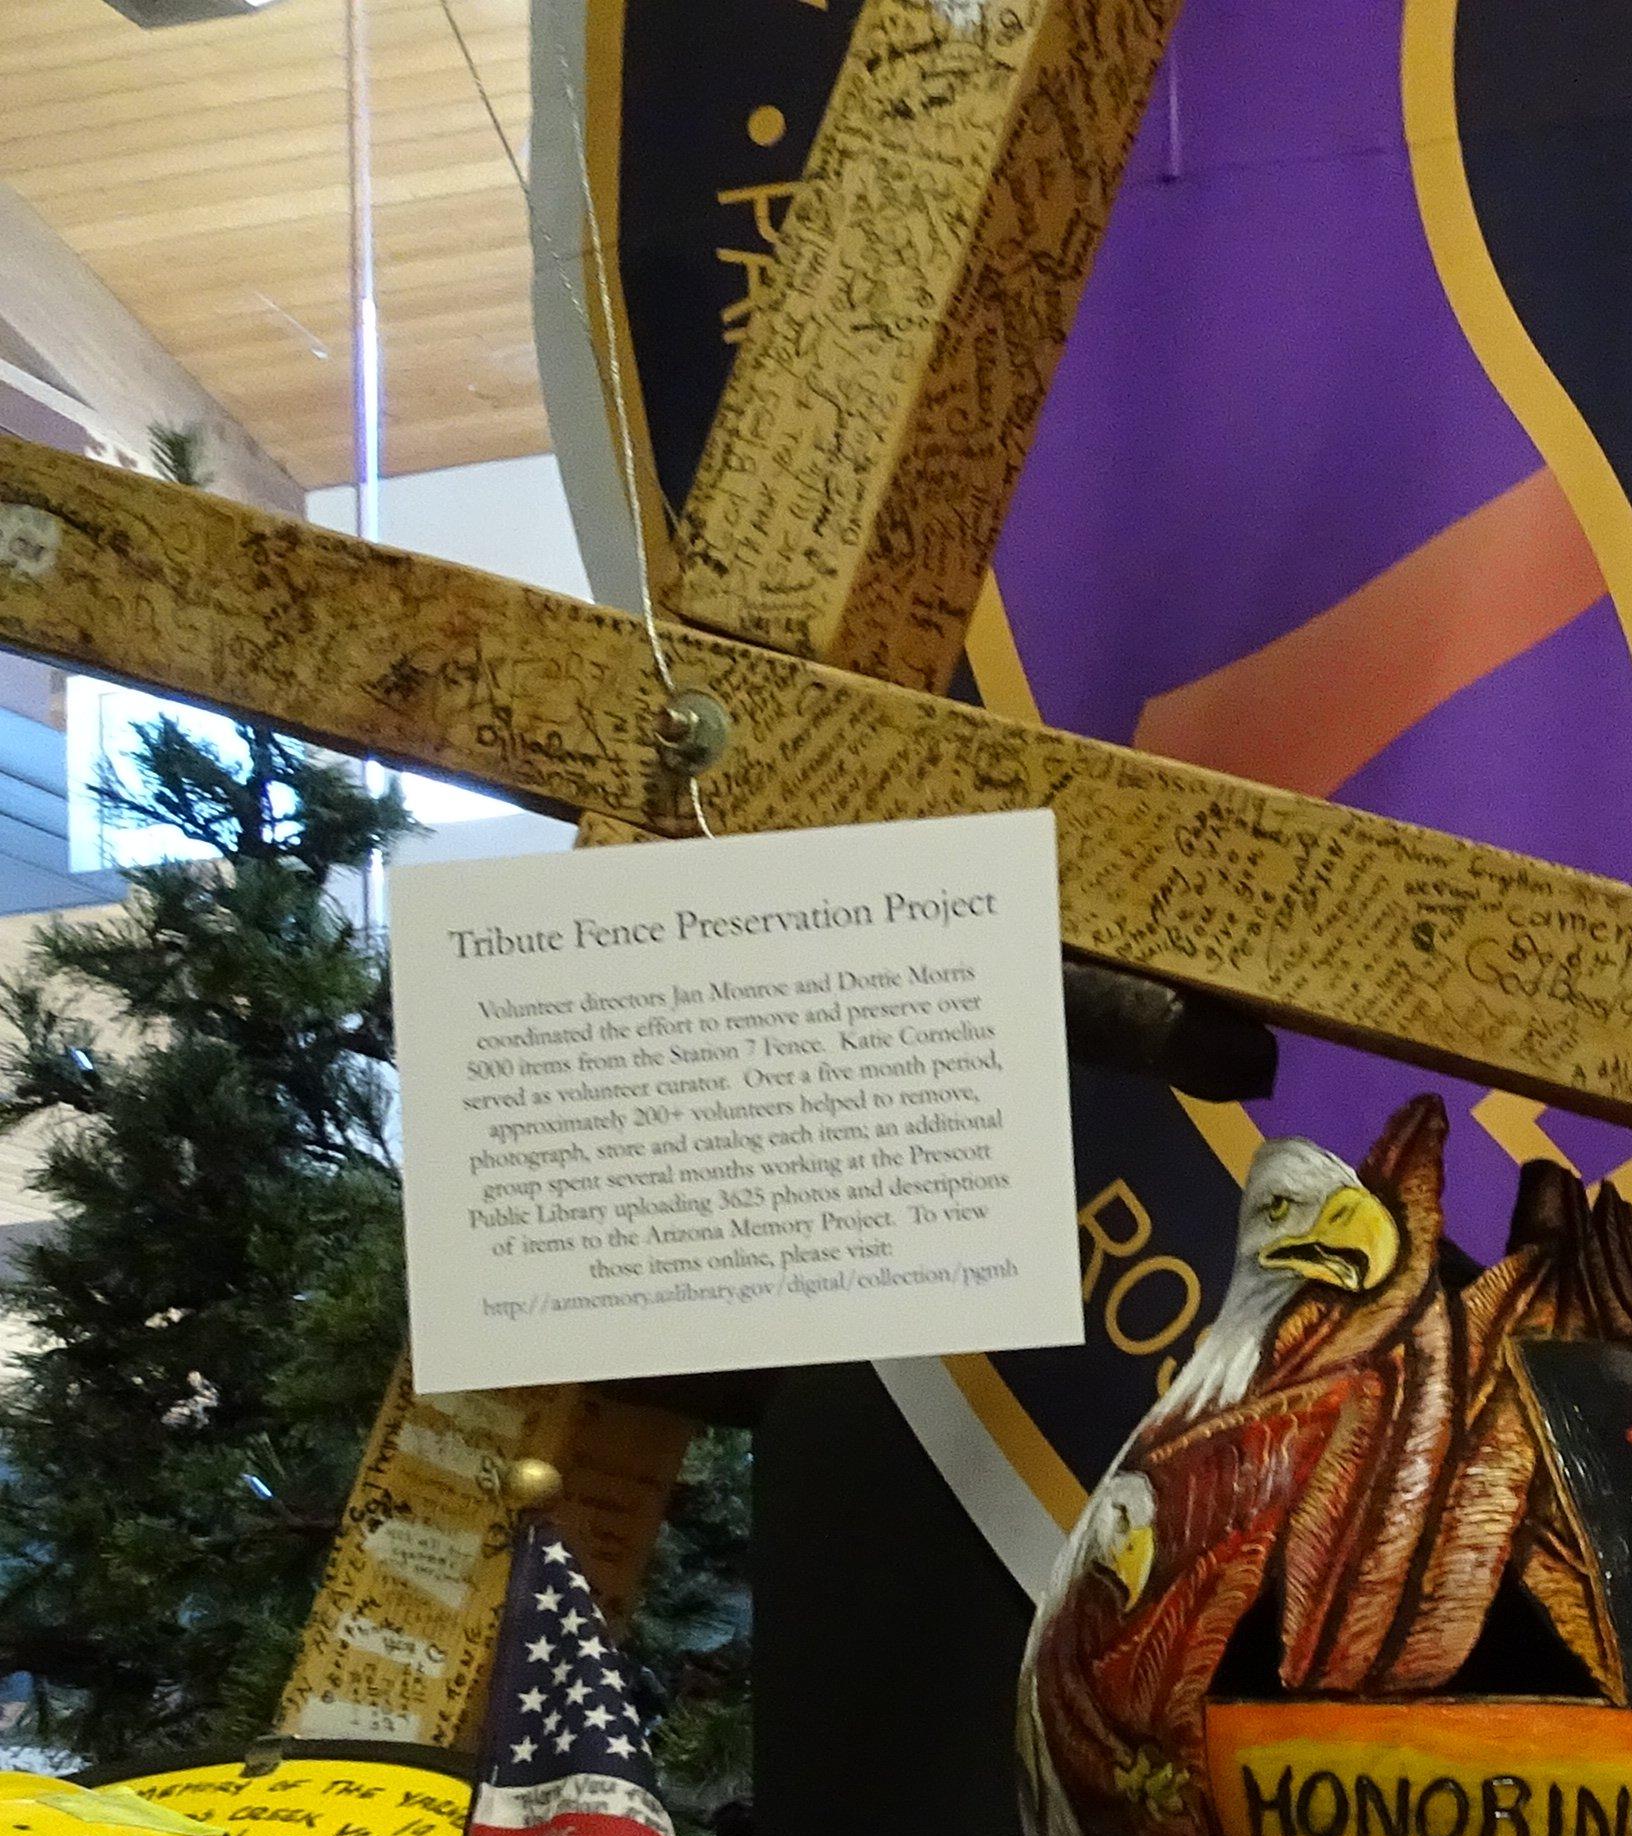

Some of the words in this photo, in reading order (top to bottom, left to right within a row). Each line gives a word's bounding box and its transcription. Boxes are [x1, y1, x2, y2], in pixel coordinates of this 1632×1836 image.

[449, 921, 563, 960] Tribute
[574, 912, 665, 949] Fence
[677, 894, 873, 941] Preservation
[884, 884, 996, 931] Project
[478, 993, 574, 1021] Volunteer
[578, 986, 667, 1012] directors
[672, 983, 704, 1010] Jan
[708, 975, 788, 1002] Monroe
[793, 972, 831, 995] and
[837, 966, 901, 991] Dottie
[907, 960, 976, 985] Morris
[466, 1057, 514, 1081] 5000
[518, 1054, 572, 1076] items
[576, 1048, 627, 1072] from
[631, 1045, 664, 1067] the
[668, 1039, 739, 1064] Station
[763, 1032, 825, 1056] Fence.
[839, 1026, 893, 1050] Katie
[897, 1018, 995, 1046] Cornelius
[487, 1108, 627, 1144] approximately
[632, 1103, 684, 1127] 200+
[689, 1094, 794, 1122] volunteers
[799, 1088, 867, 1119] helped
[871, 1088, 894, 1107] to
[899, 1086, 978, 1108] remove,
[468, 1204, 531, 1229] Public
[536, 1198, 607, 1229] Library
[613, 1190, 712, 1223] uploading
[717, 1186, 765, 1209] 3625
[770, 1180, 841, 1211] photos
[845, 1177, 884, 1199] and
[887, 1167, 1010, 1202] descriptions
[1077, 1177, 1212, 1400] RO
